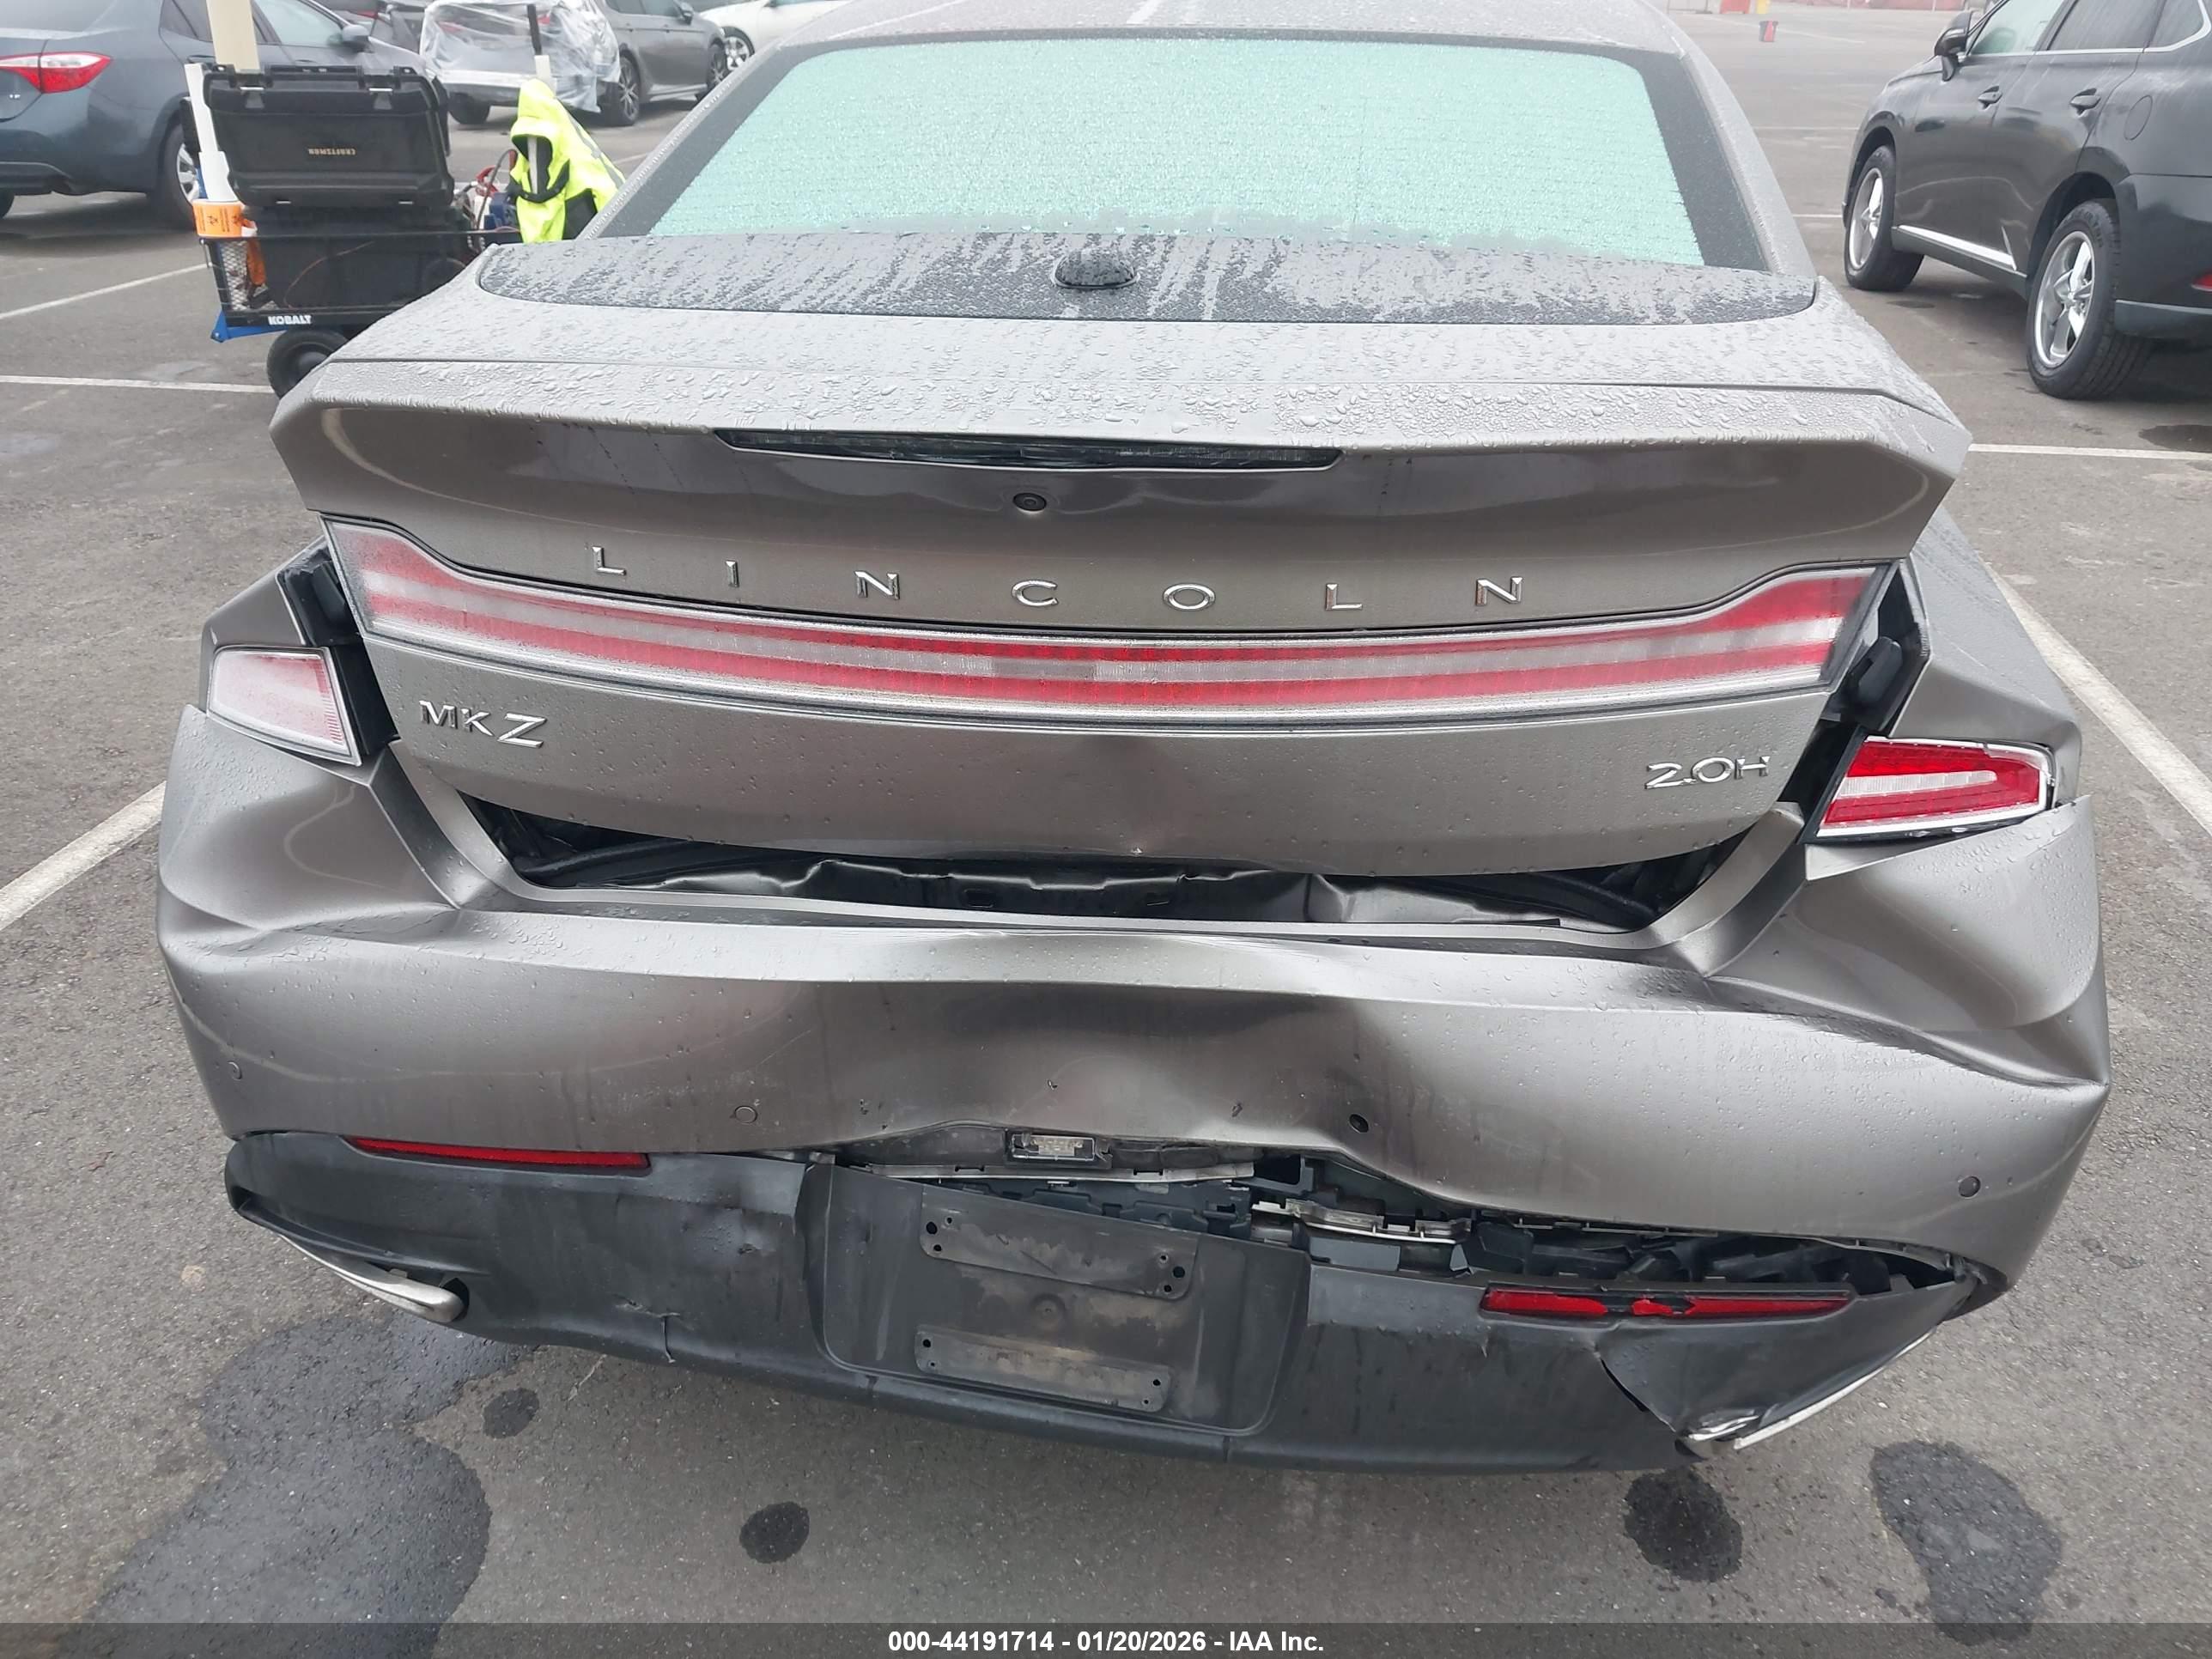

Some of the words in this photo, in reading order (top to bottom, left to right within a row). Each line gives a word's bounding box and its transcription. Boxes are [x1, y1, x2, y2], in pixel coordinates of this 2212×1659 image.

[268, 314, 312, 325] KOBALT
[591, 545, 1523, 611] LINCOLN
[419, 700, 547, 749] MKZ
